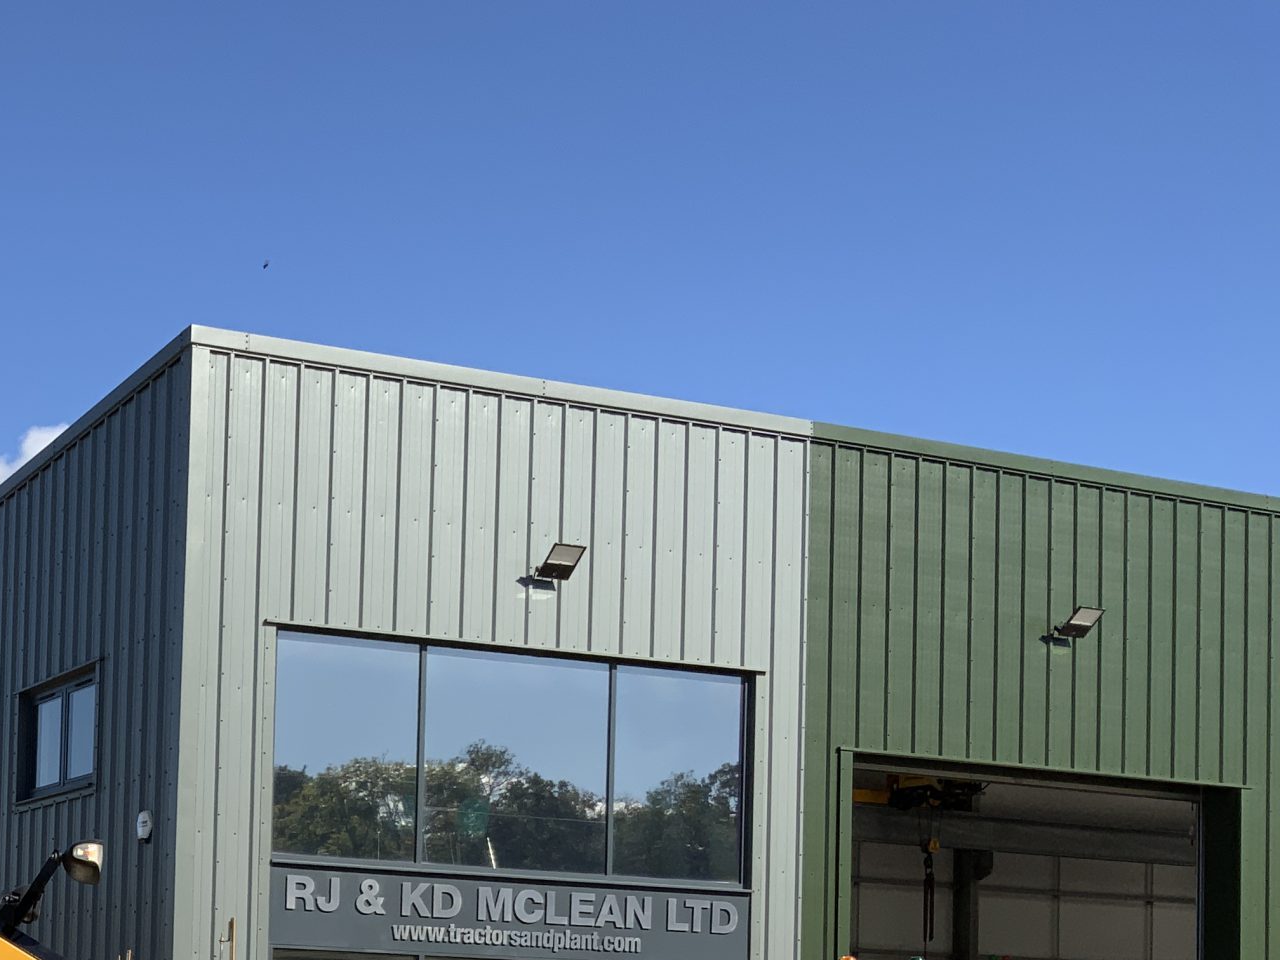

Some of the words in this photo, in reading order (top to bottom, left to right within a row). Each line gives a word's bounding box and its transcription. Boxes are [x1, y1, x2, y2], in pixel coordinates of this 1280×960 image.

[285, 874, 340, 912] RJ
[355, 878, 386, 915] &
[401, 881, 462, 919] KD
[477, 886, 652, 930] MCLEAN
[666, 897, 739, 935] LTD
[392, 922, 642, 953] www.tractorsandplant.com
